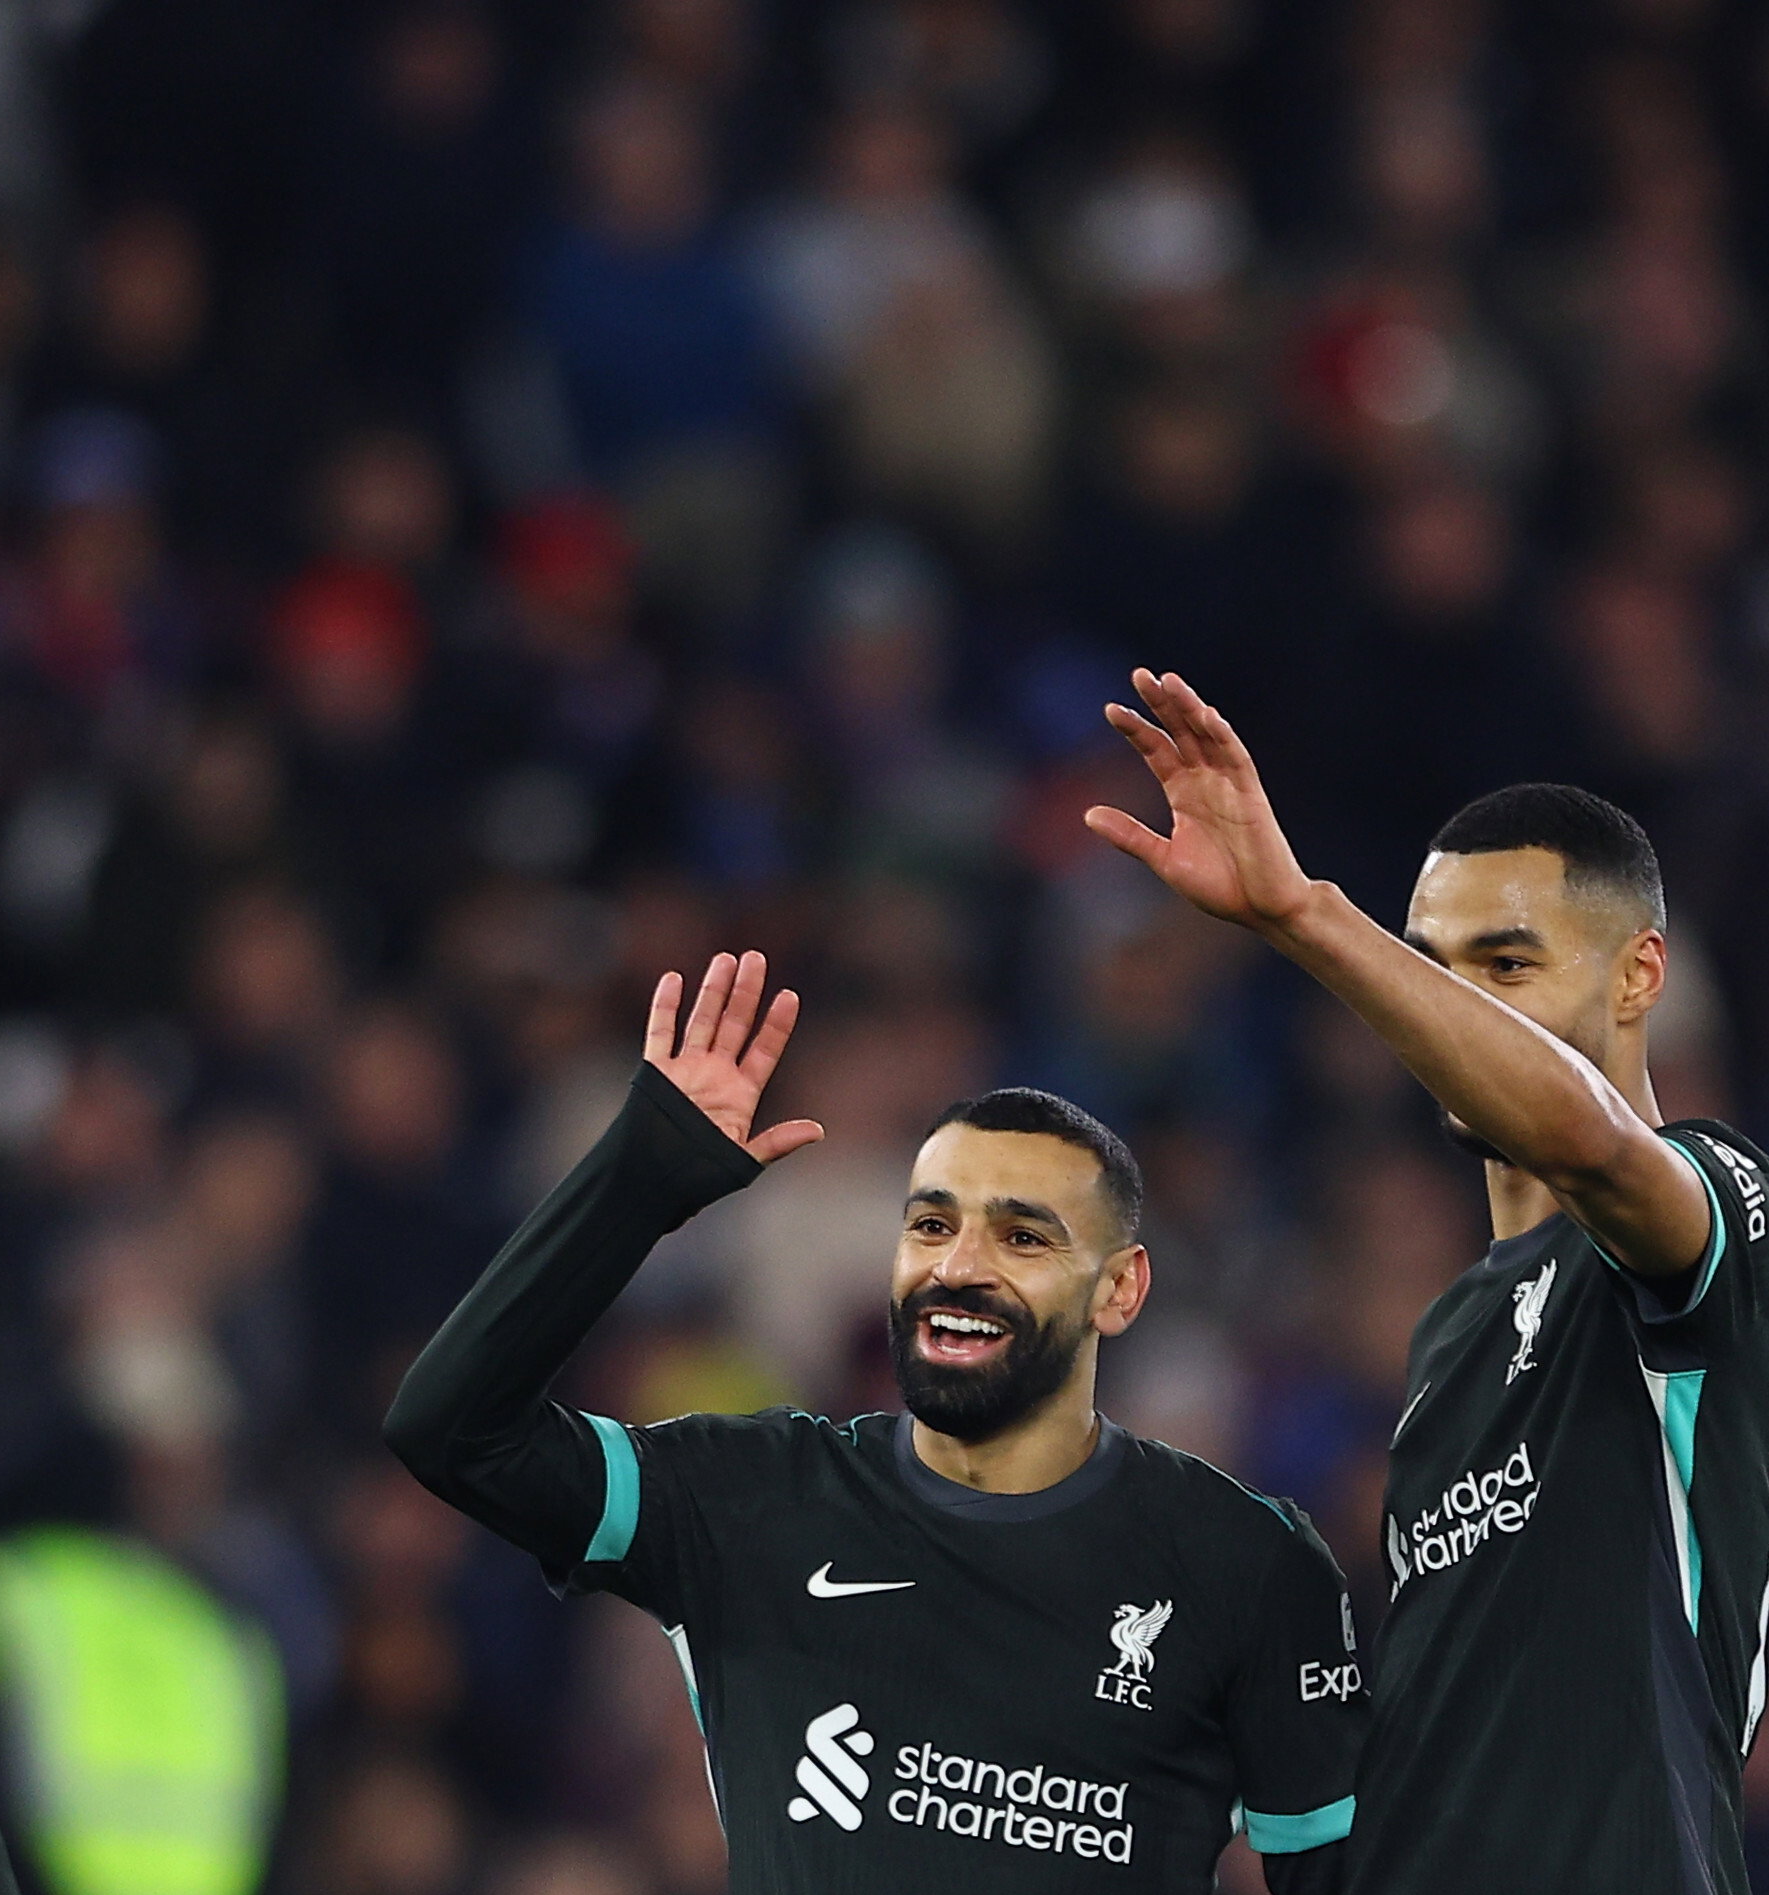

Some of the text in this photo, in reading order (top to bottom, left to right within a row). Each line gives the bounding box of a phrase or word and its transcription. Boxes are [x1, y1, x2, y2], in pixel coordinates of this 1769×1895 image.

[1095, 1674, 1153, 1711] L.F.C.
[1300, 1661, 1362, 1702] Exp
[894, 1742, 1129, 1820] standard
[888, 1785, 1133, 1864] chartered
